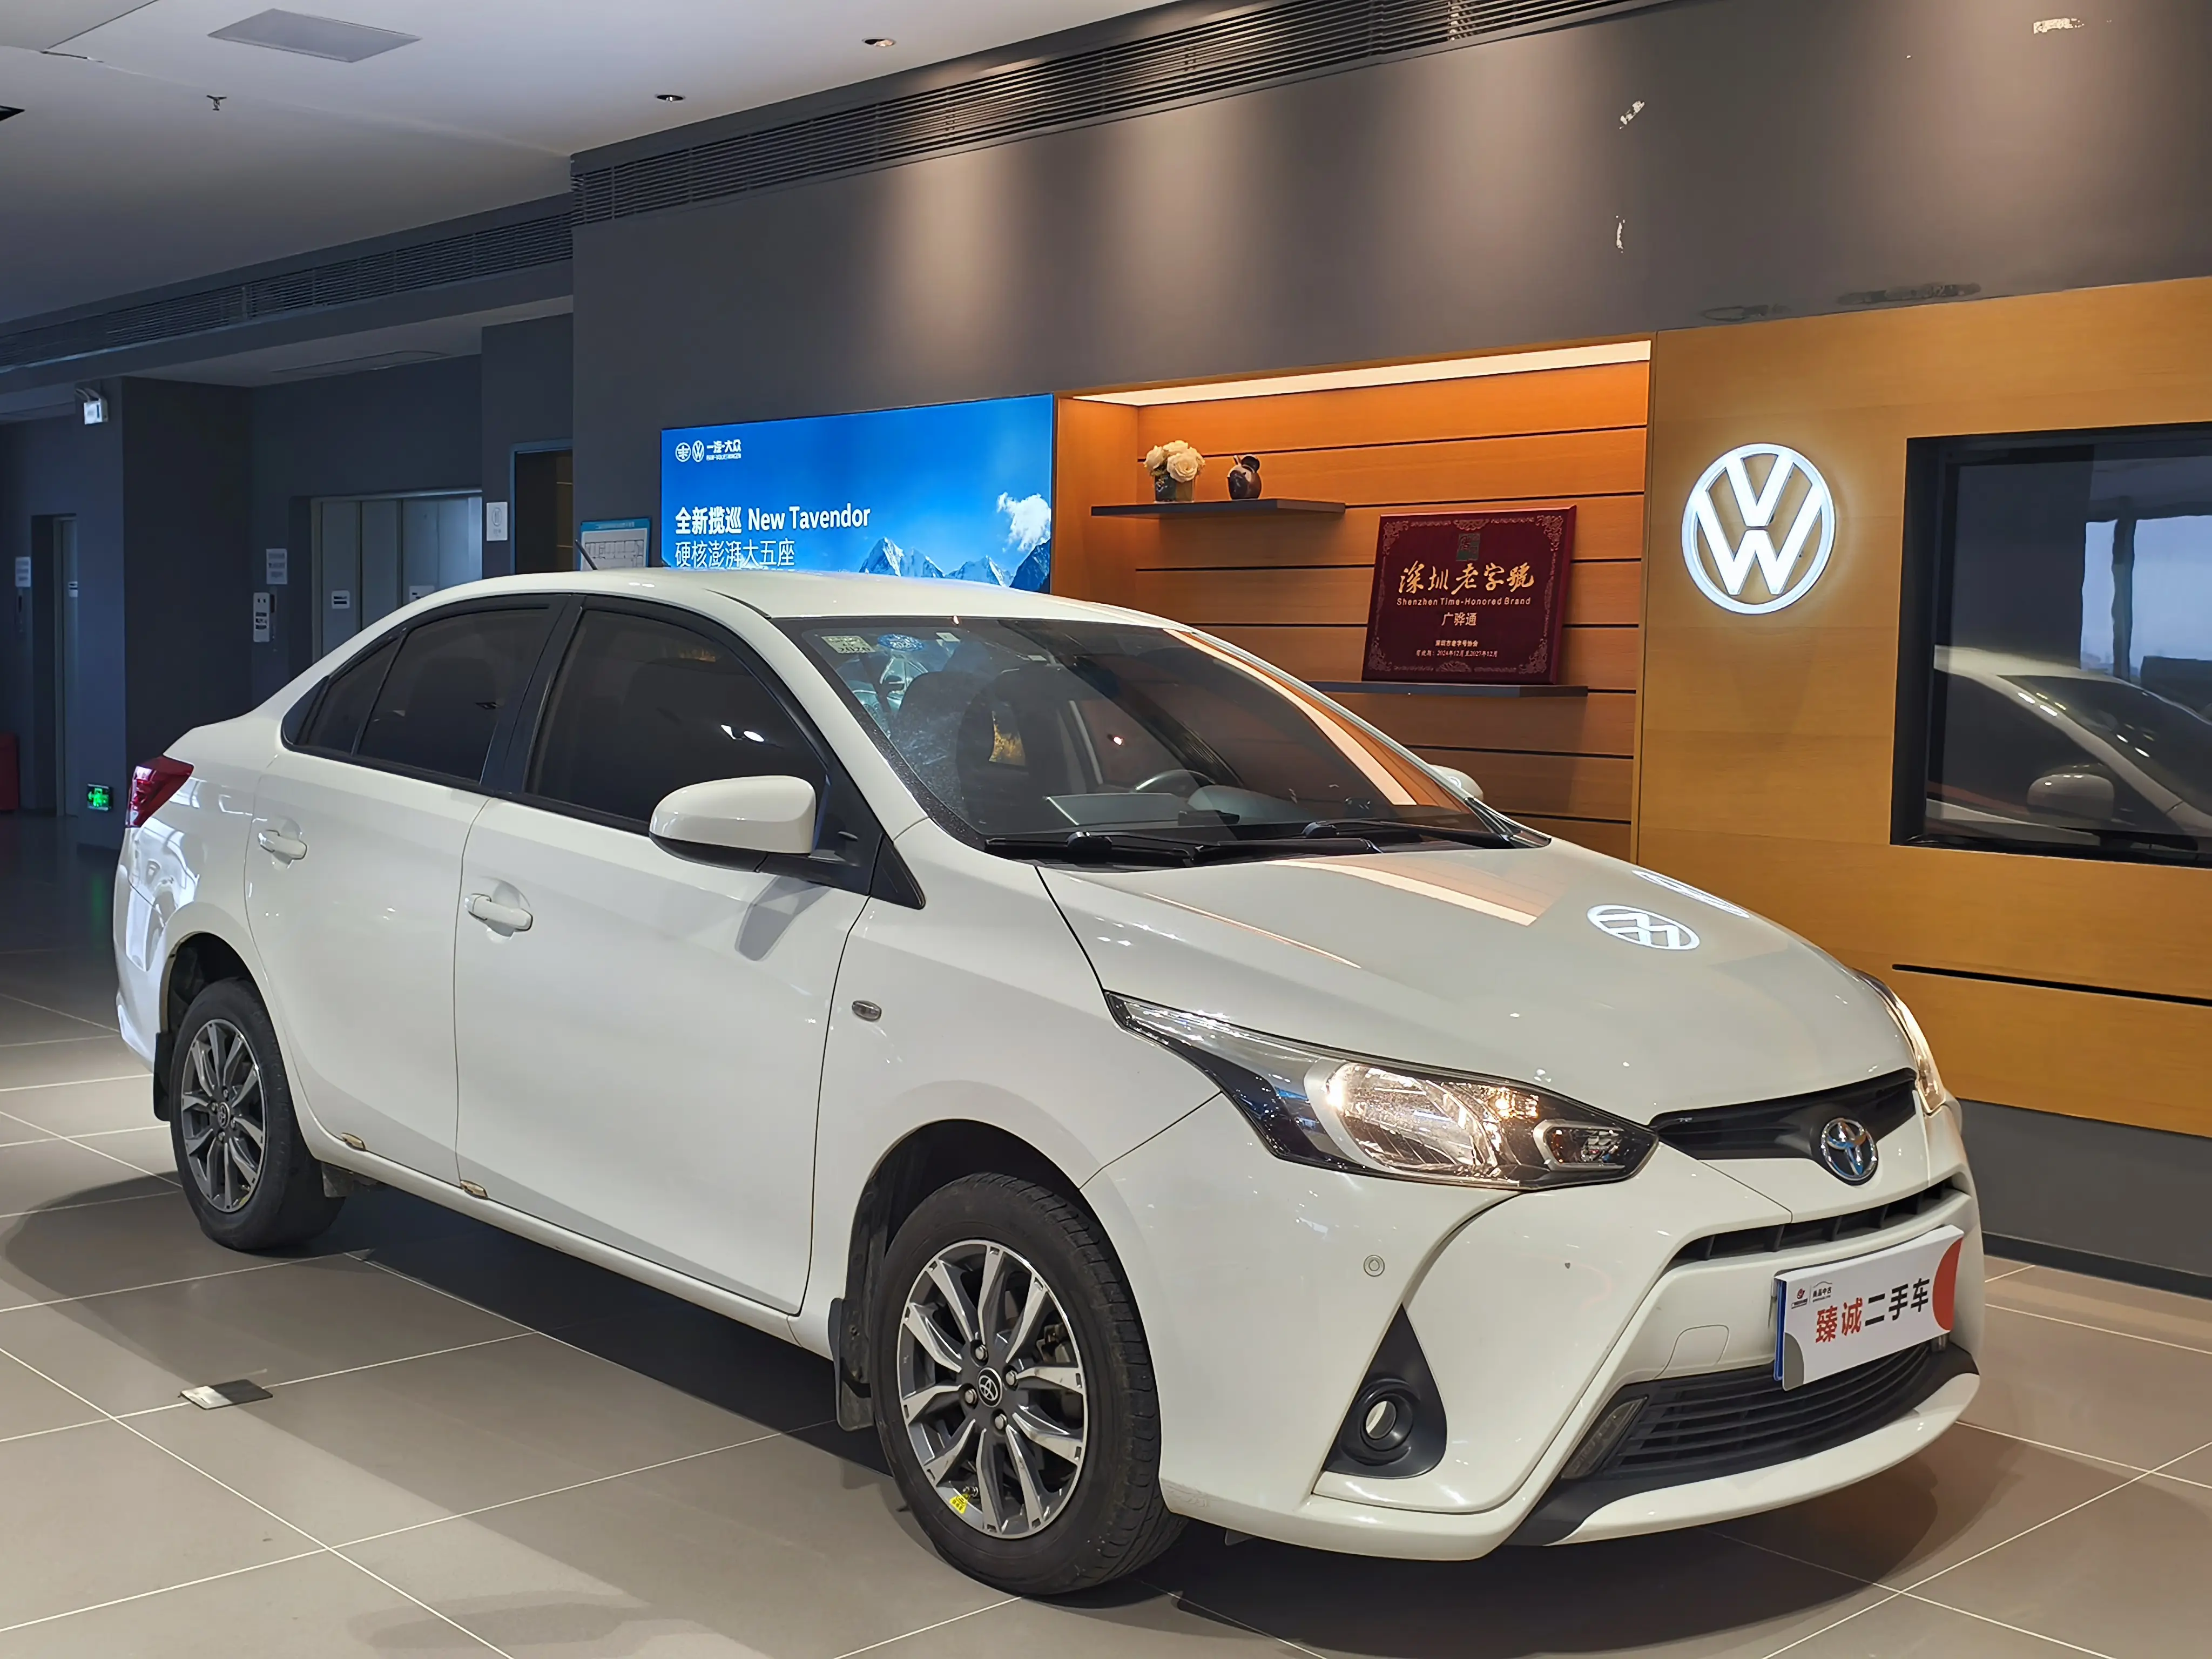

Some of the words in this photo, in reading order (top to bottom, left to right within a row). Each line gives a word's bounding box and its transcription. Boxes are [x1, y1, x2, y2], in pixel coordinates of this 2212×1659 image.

[675, 506, 742, 535] 全新揽巡
[748, 508, 785, 531] New
[789, 503, 871, 530] Tavendor
[675, 537, 795, 568] 硬核澎湃大五座
[1397, 597, 1438, 606] Shenzhen
[1440, 597, 1502, 606] Time-Honored
[1504, 597, 1531, 605] Brand
[1815, 1278, 1930, 1344] 臻诚二手车
